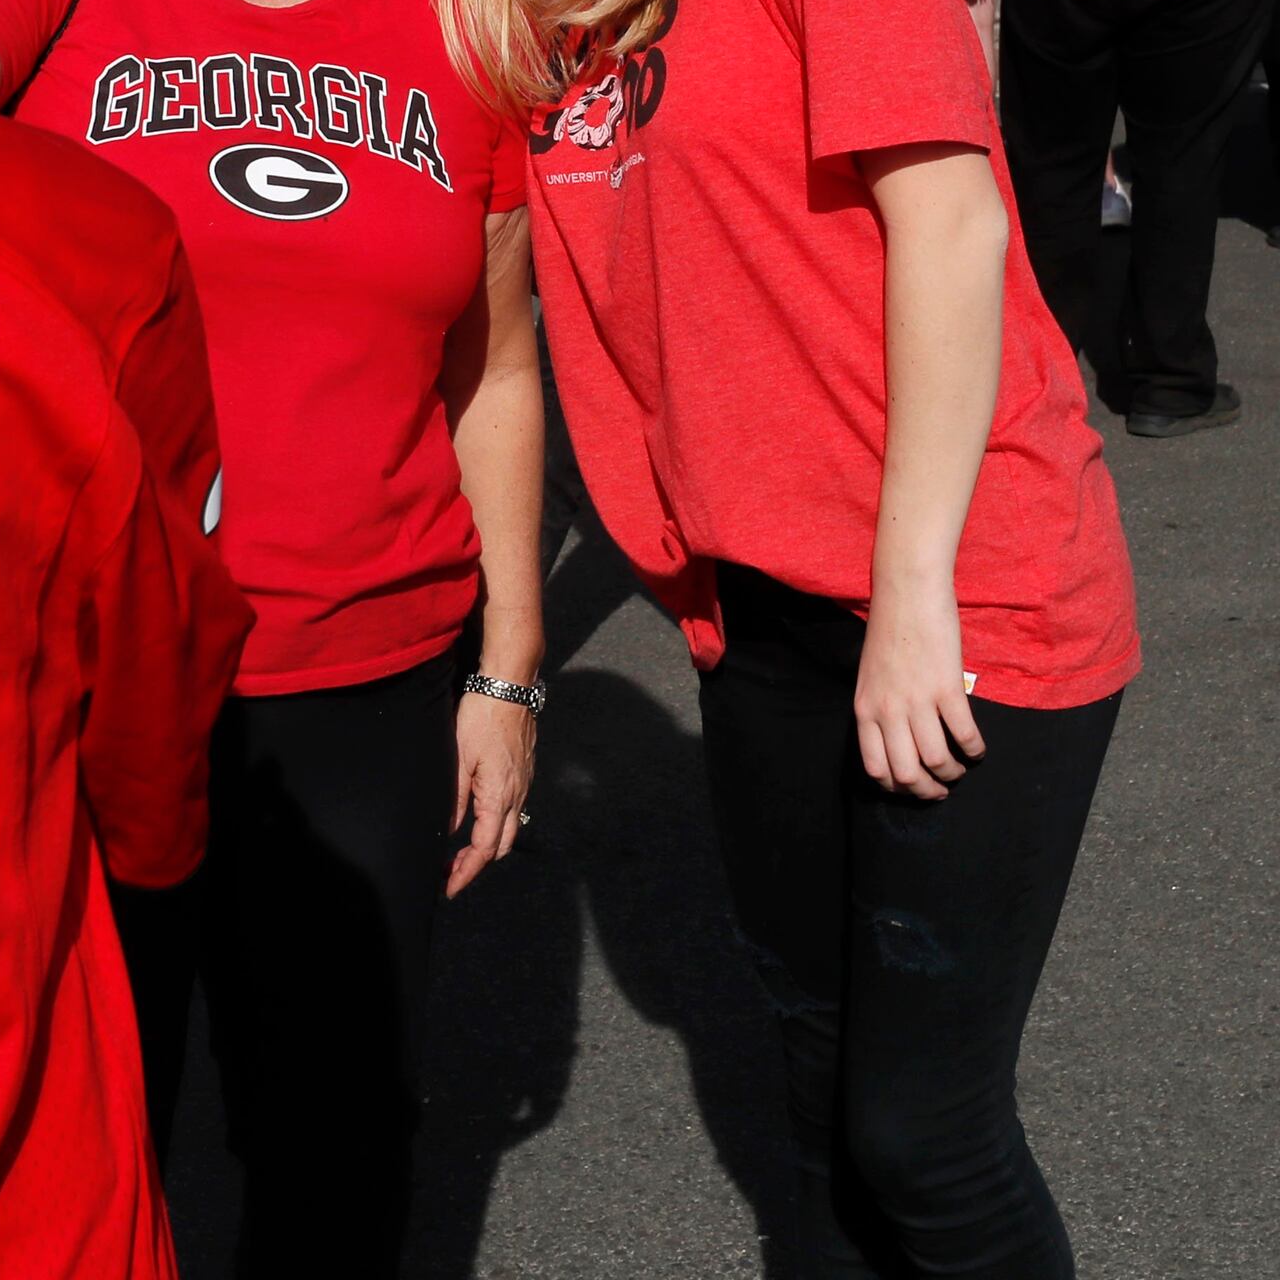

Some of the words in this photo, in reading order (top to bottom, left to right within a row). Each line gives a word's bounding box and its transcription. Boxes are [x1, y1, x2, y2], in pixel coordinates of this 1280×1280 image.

[86, 52, 453, 193] GEORGIA
[209, 143, 349, 220] G
[546, 170, 610, 186] UNIVERSITY
